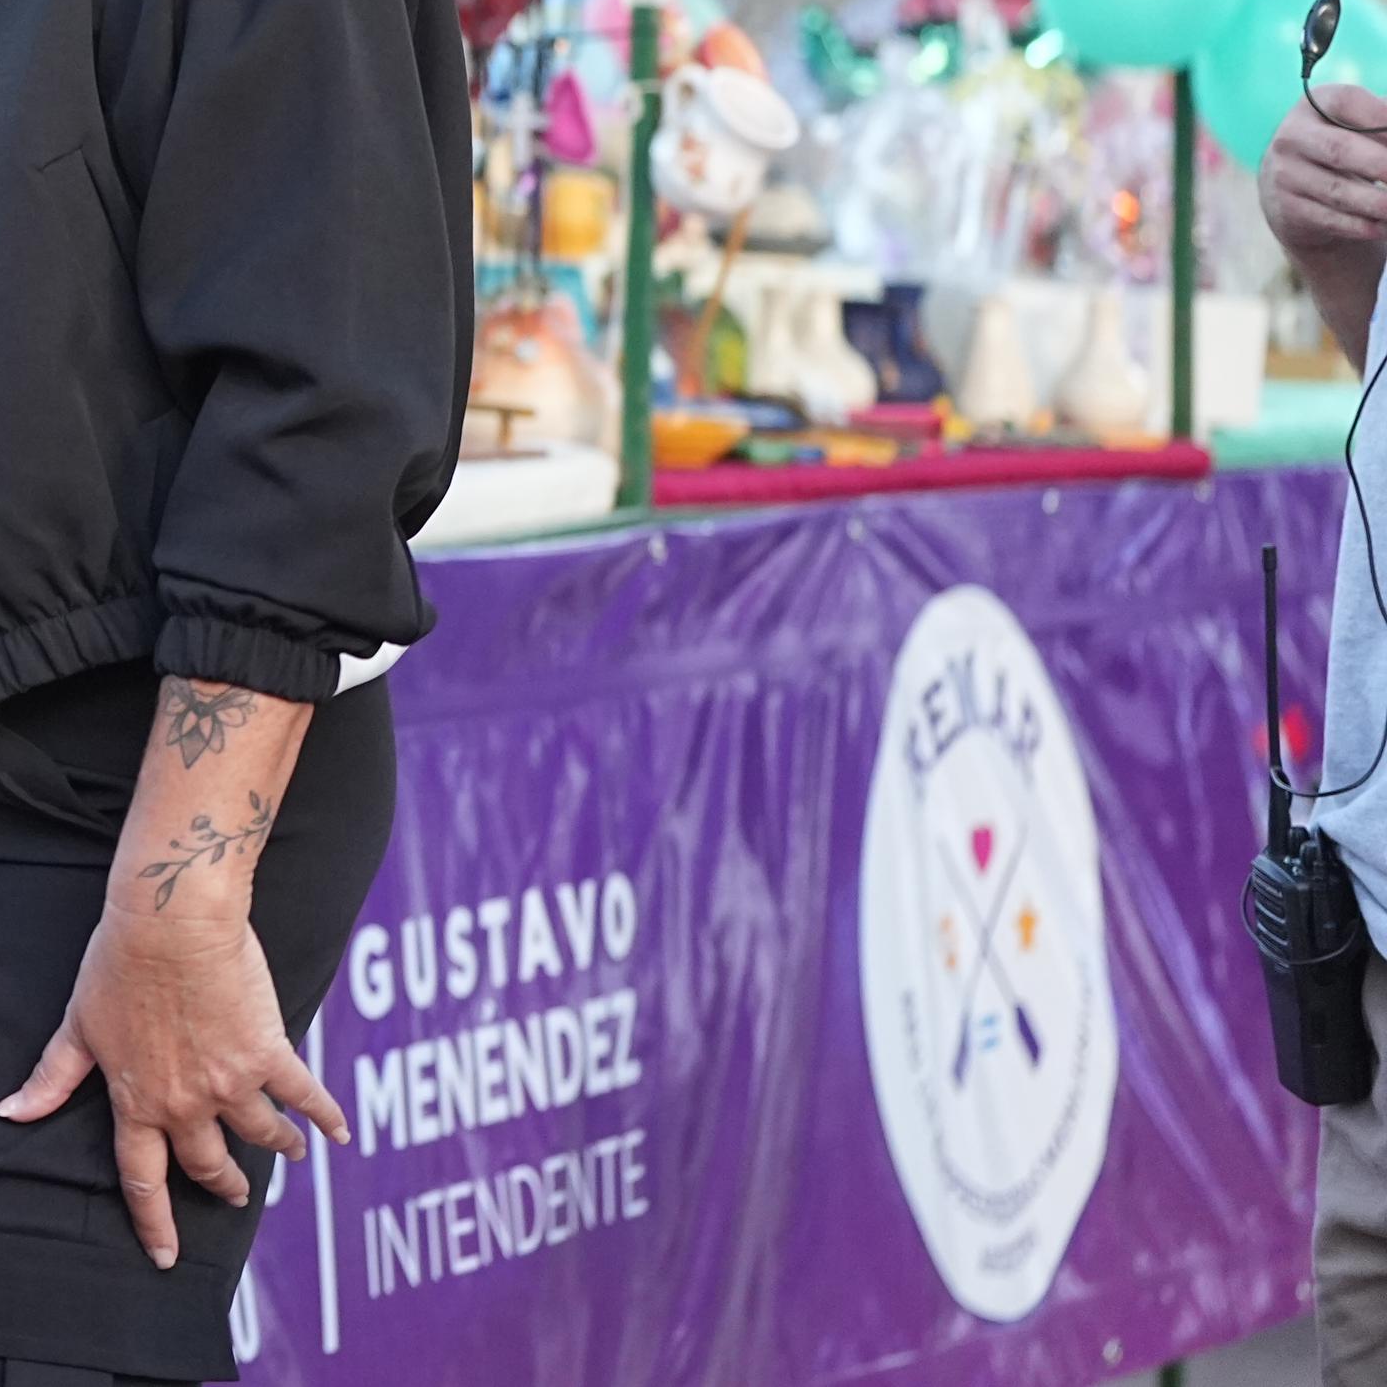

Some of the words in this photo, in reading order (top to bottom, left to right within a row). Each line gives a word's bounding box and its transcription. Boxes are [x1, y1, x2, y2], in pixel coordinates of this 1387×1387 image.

[349, 872, 639, 1021] GUSTAVO
[354, 989, 642, 1159] MENÉNDEZ
[363, 1129, 650, 1301] INTENDENTE
